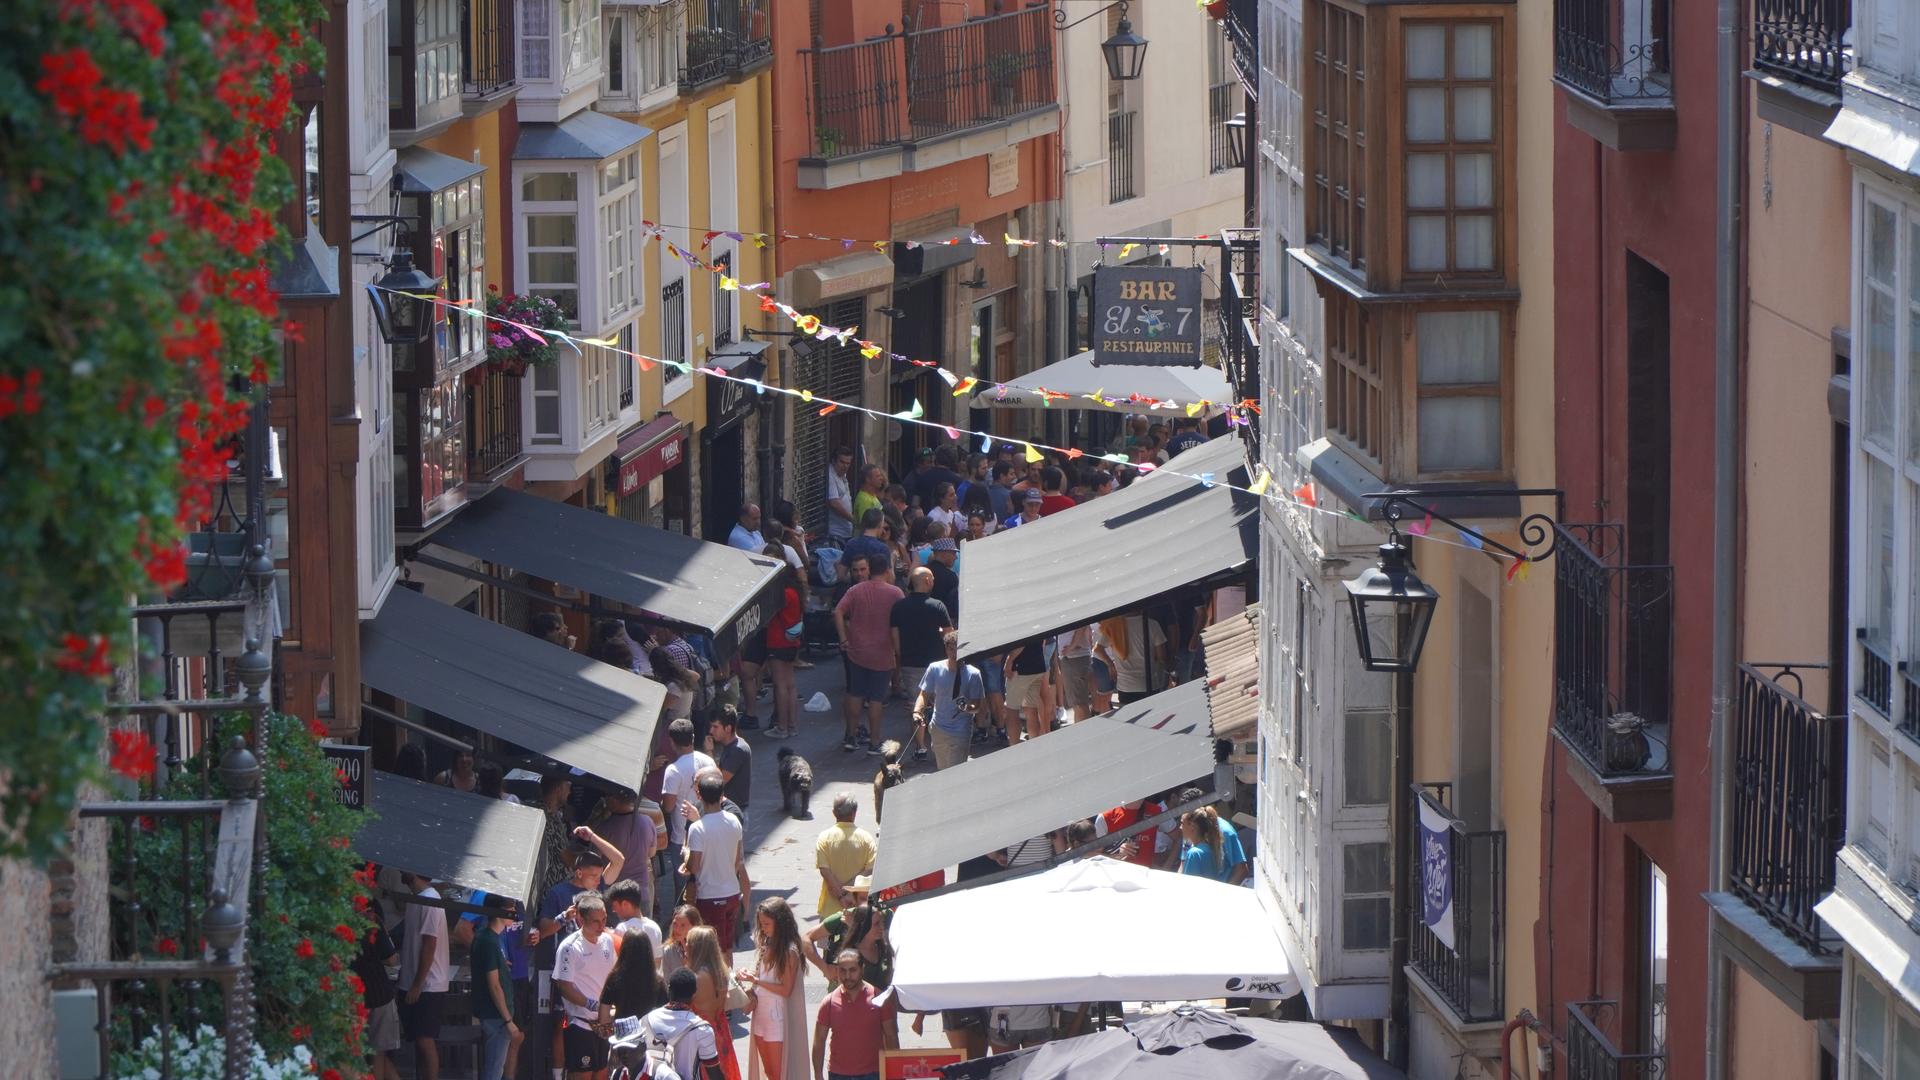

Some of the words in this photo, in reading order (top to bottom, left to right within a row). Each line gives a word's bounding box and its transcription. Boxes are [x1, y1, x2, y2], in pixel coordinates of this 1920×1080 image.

[1119, 280, 1177, 301] BAR
[1103, 305, 1131, 335] El
[1176, 307, 1193, 336] 7
[1103, 340, 1194, 354] RESTAURANTE
[995, 397, 1022, 405] AMBAR
[326, 756, 361, 782] TTOO
